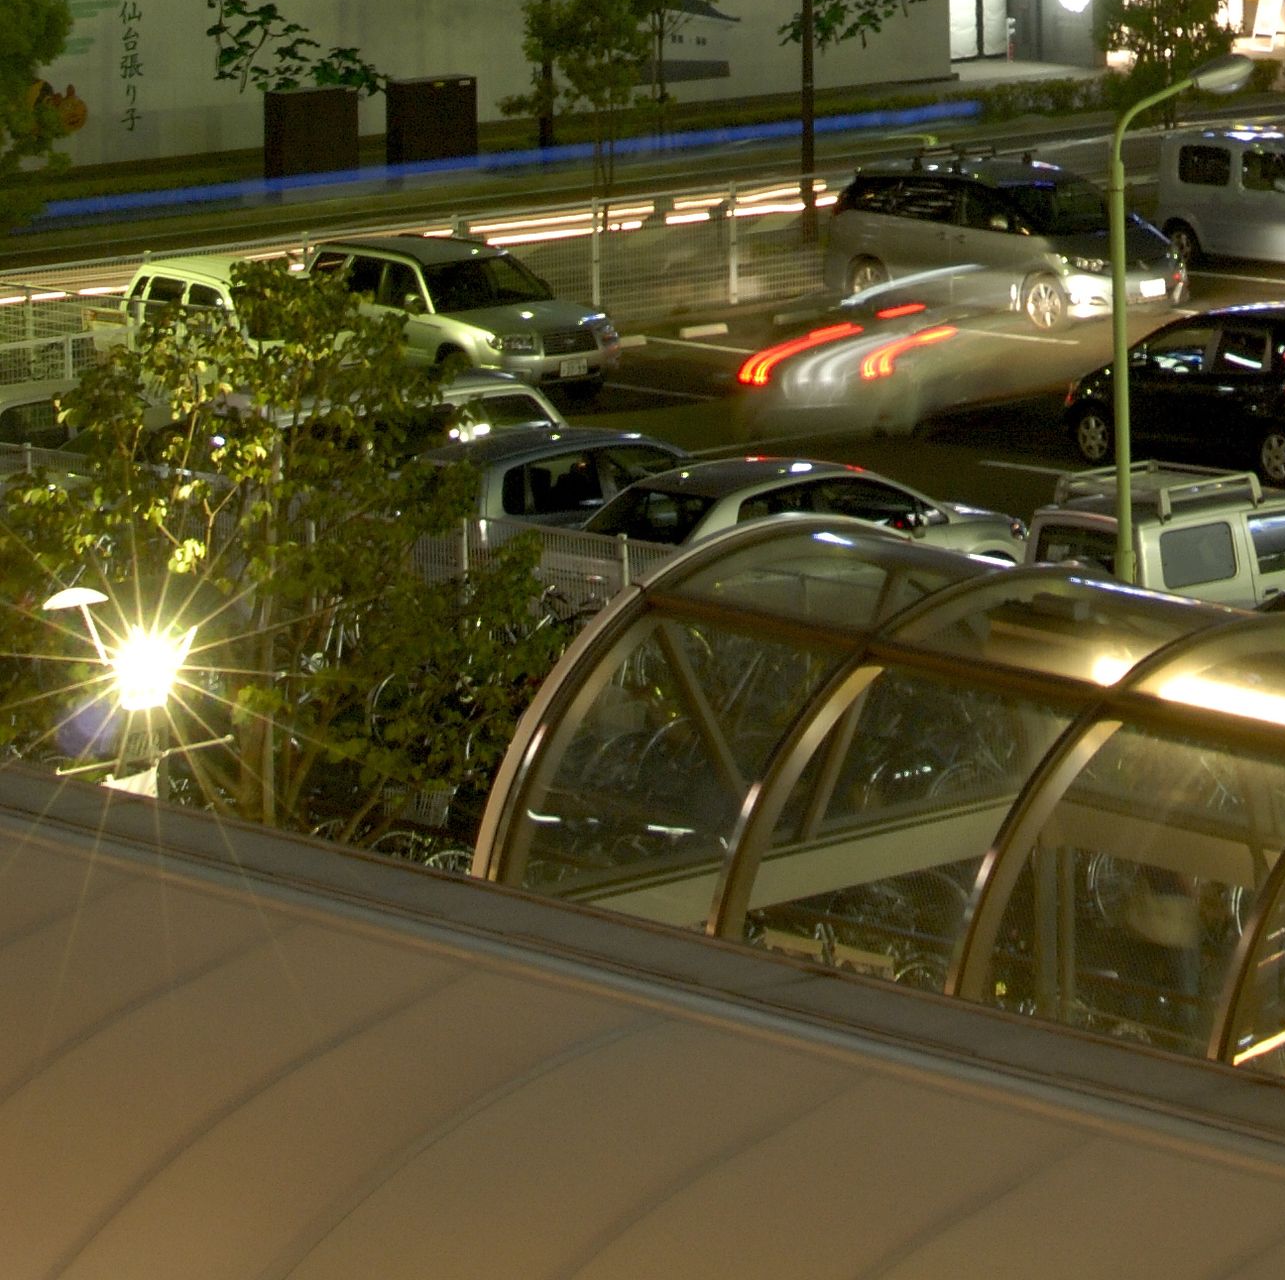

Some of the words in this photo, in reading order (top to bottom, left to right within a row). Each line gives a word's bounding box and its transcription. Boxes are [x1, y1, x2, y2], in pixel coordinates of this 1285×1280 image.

[119, 0, 144, 132] 仙台張り子
